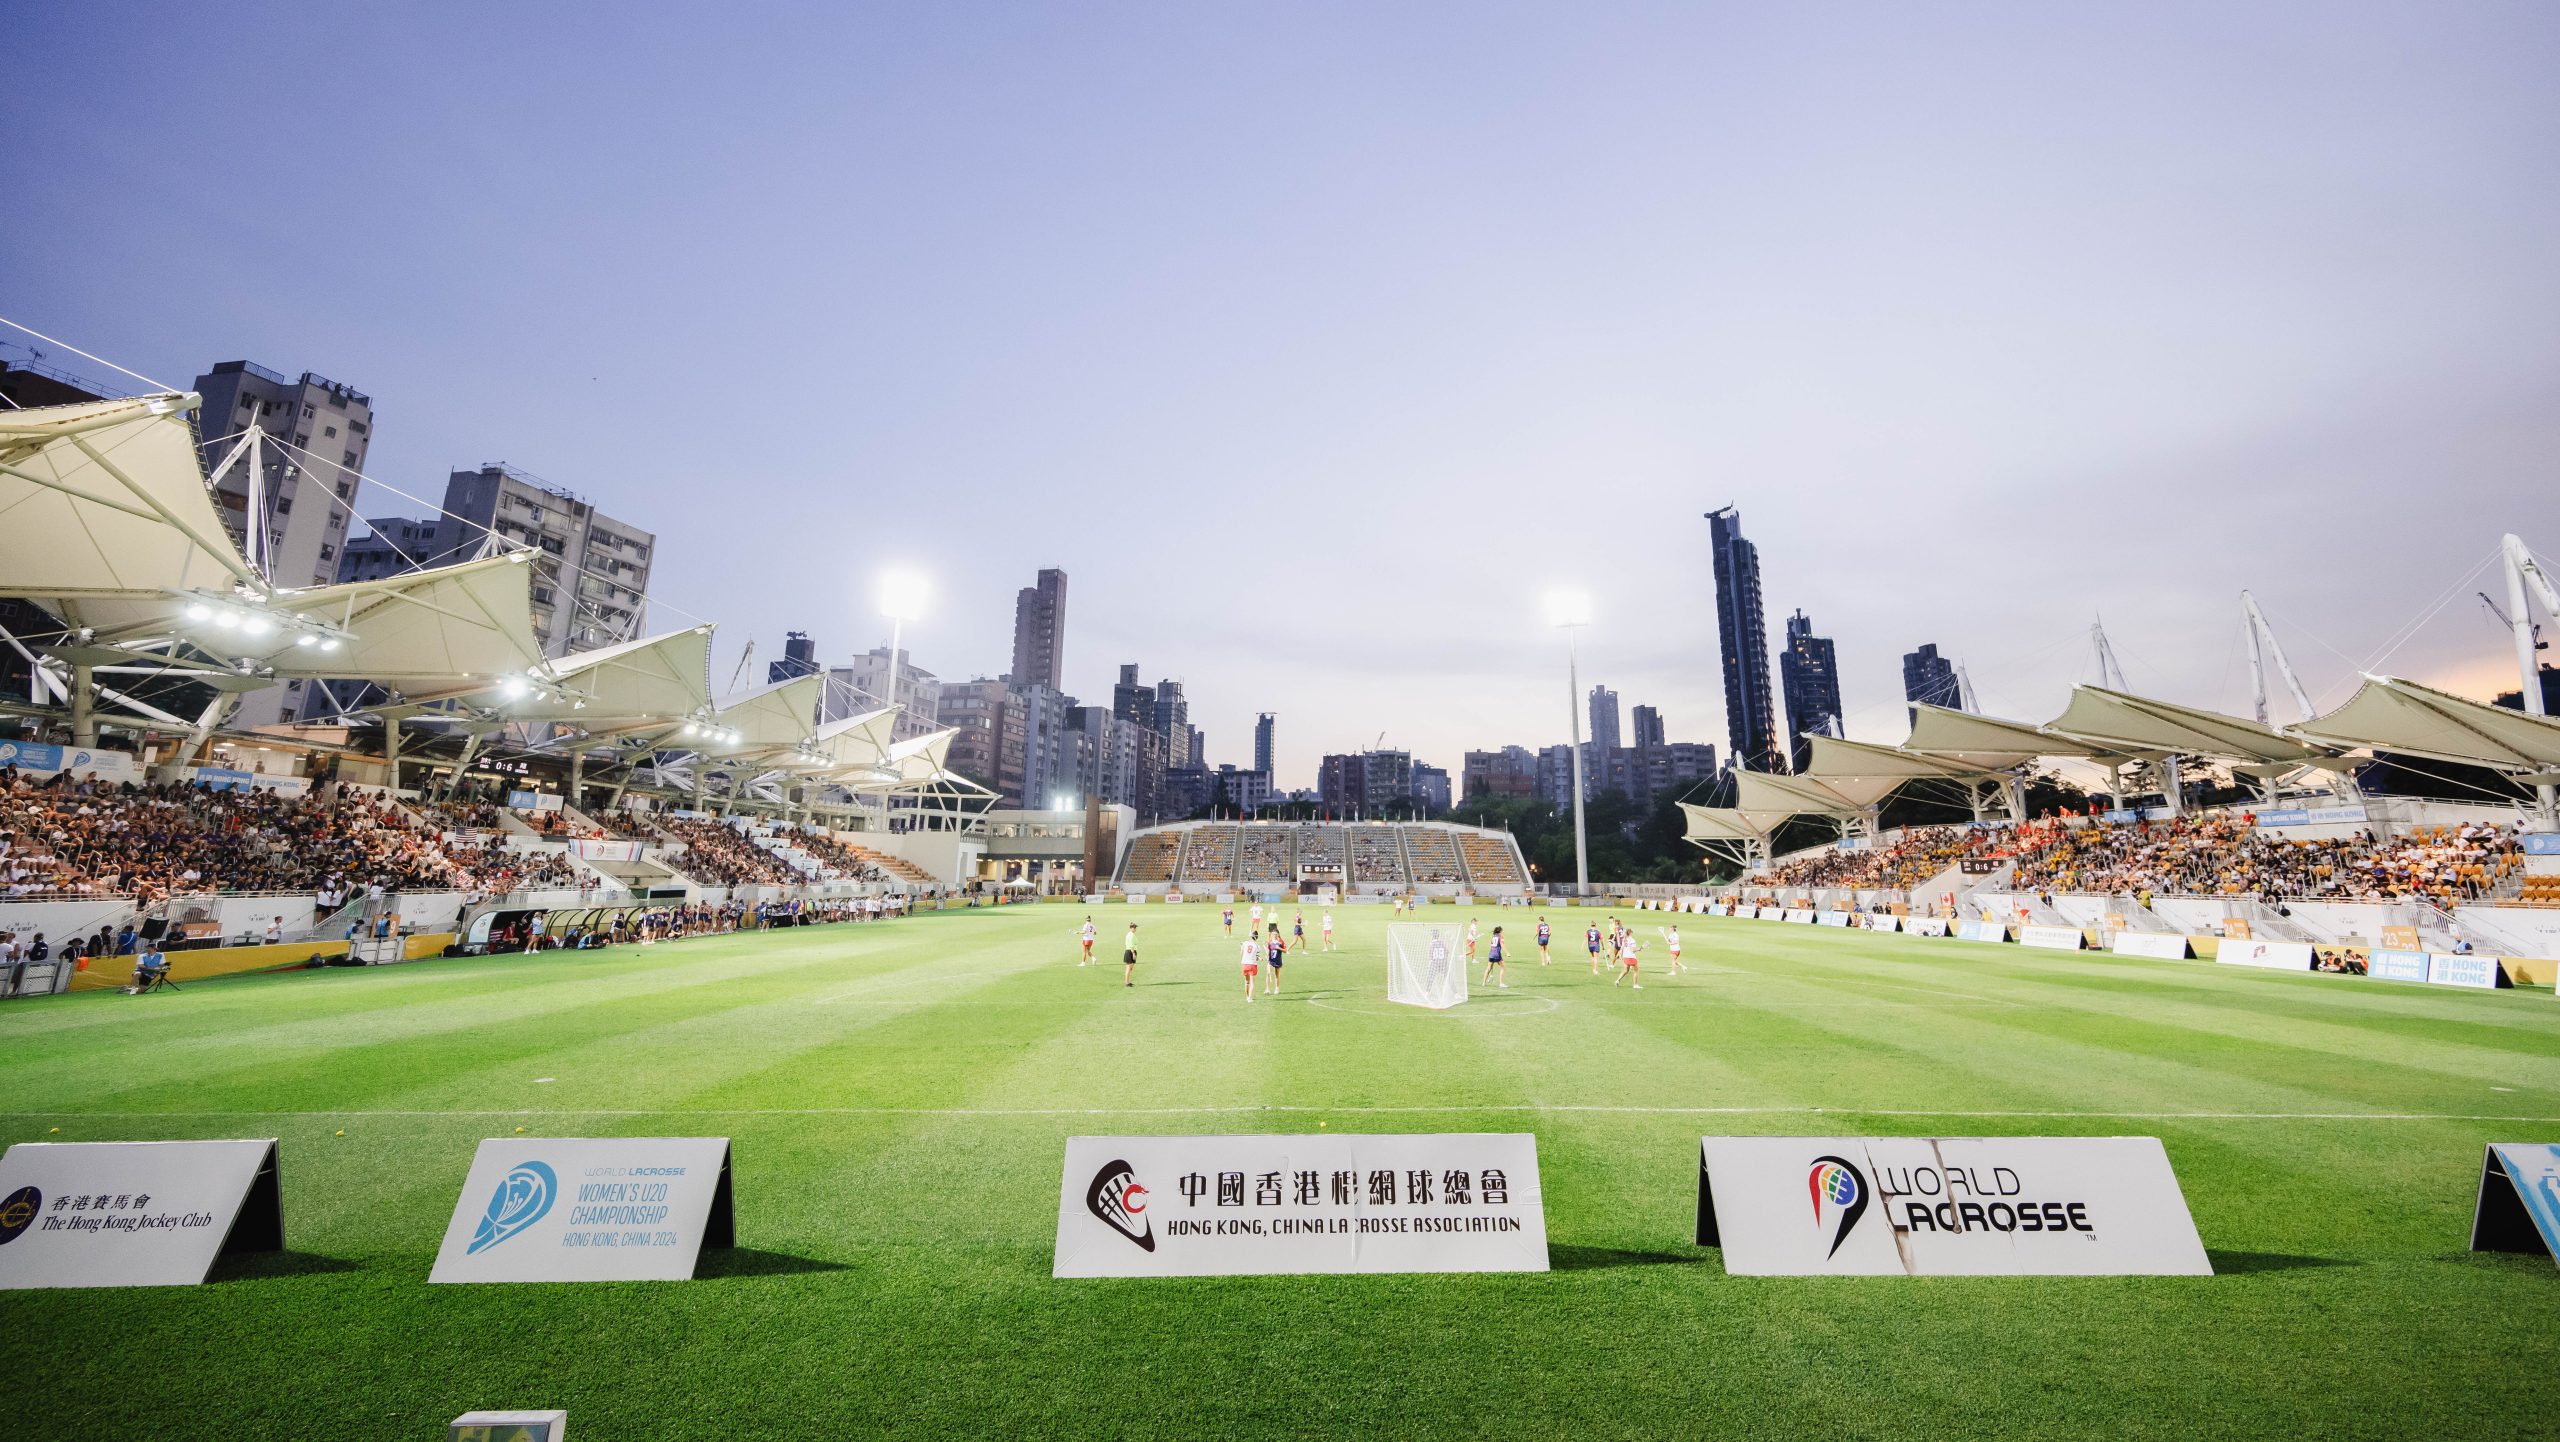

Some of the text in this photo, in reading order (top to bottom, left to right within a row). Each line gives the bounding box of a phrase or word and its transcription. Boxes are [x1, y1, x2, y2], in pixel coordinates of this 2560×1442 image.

[2384, 932, 2399, 946] 23
[2389, 953, 2420, 966] HONG
[2452, 959, 2487, 972] HONG
[2387, 965, 2420, 978] KONG
[2451, 971, 2486, 984] KONG
[584, 1167, 687, 1177] WORLD LACROSSE
[1179, 1169, 1509, 1207] 中國香港棍網球總會
[1873, 1167, 2021, 1196] WORLD
[578, 1183, 668, 1202] WOMEN'S U20
[52, 1193, 152, 1211] 香港賽馬會
[41, 1212, 212, 1234] The Hong Kong Jockey Club
[569, 1205, 669, 1225] CHAMPIONSHIP
[1168, 1219, 1212, 1236] HONG
[1217, 1219, 1268, 1237] KONG,
[1272, 1218, 1324, 1235] CHINA
[1413, 1216, 1521, 1233] ASSOCIATION
[561, 1231, 678, 1248] HONG KONG, CHINA 2024
